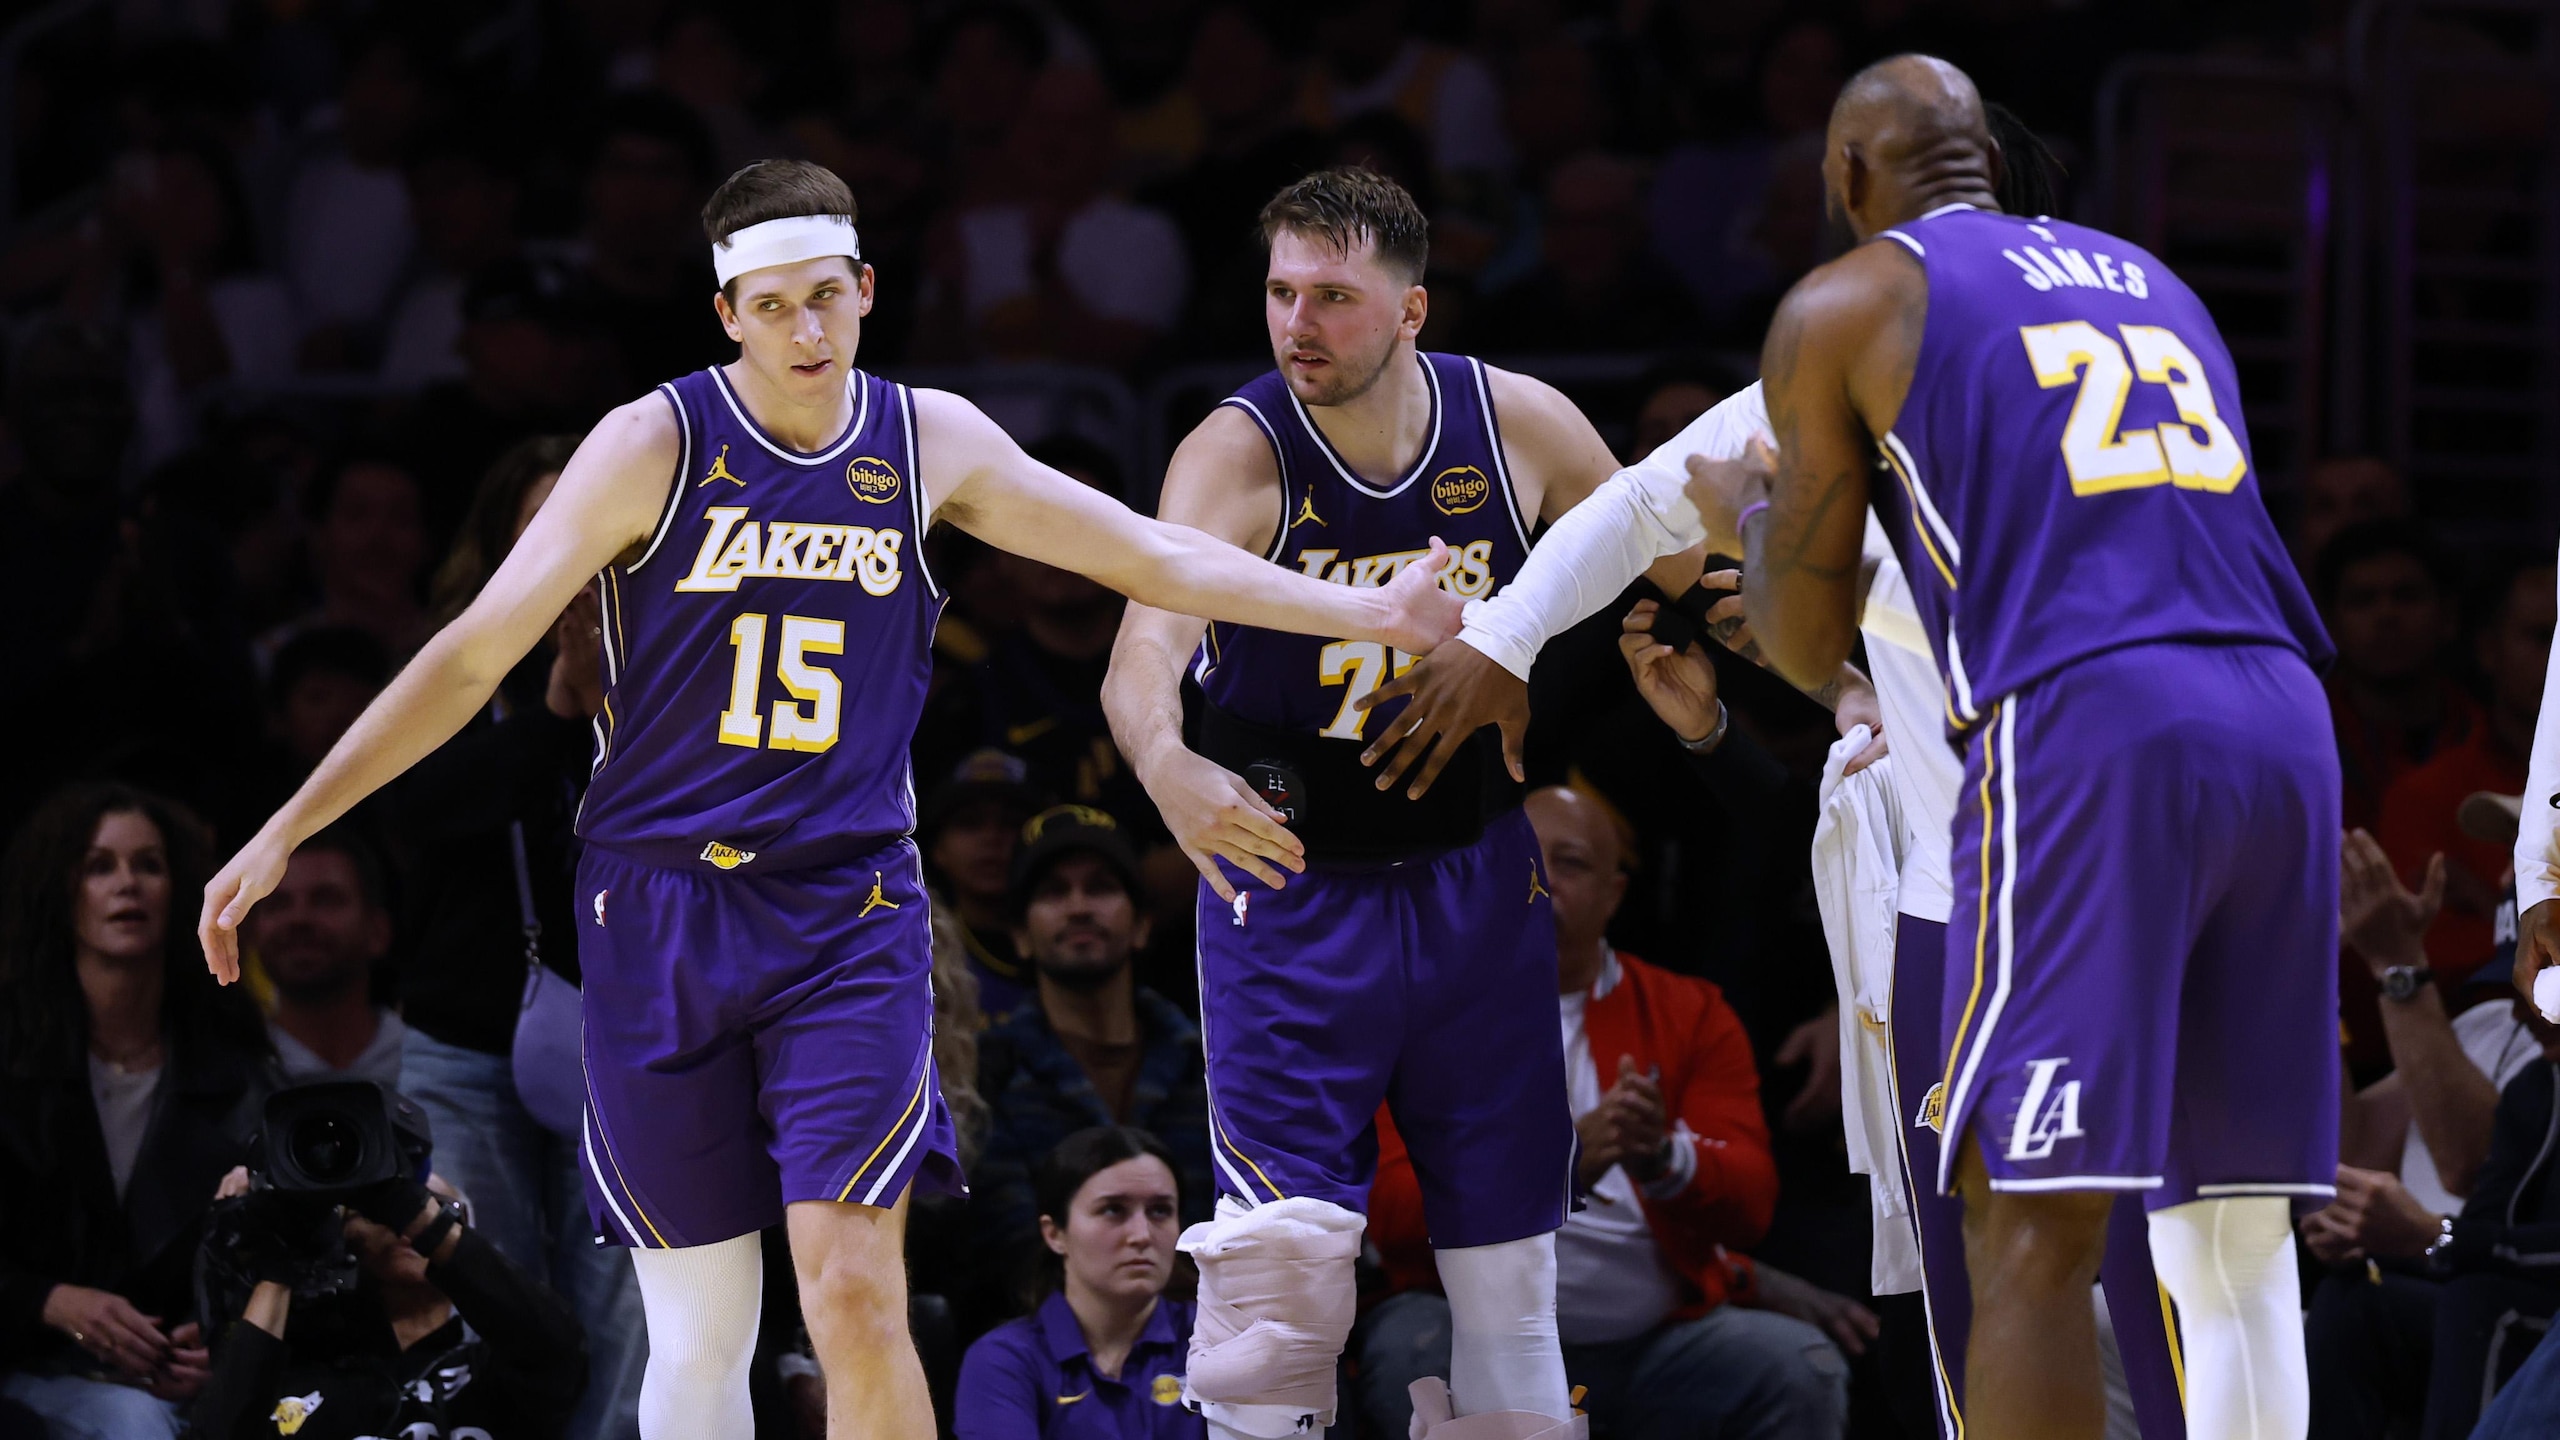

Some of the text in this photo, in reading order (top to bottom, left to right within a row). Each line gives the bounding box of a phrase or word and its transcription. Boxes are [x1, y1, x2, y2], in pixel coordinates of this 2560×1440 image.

[2002, 245, 2149, 300] JAMES
[2018, 319, 2248, 497] 23
[851, 467, 896, 491] bibigo
[1436, 479, 1485, 499] bibigo
[674, 506, 904, 597] LAKERS
[717, 612, 845, 754] 15
[2003, 1057, 2085, 1161] LA
